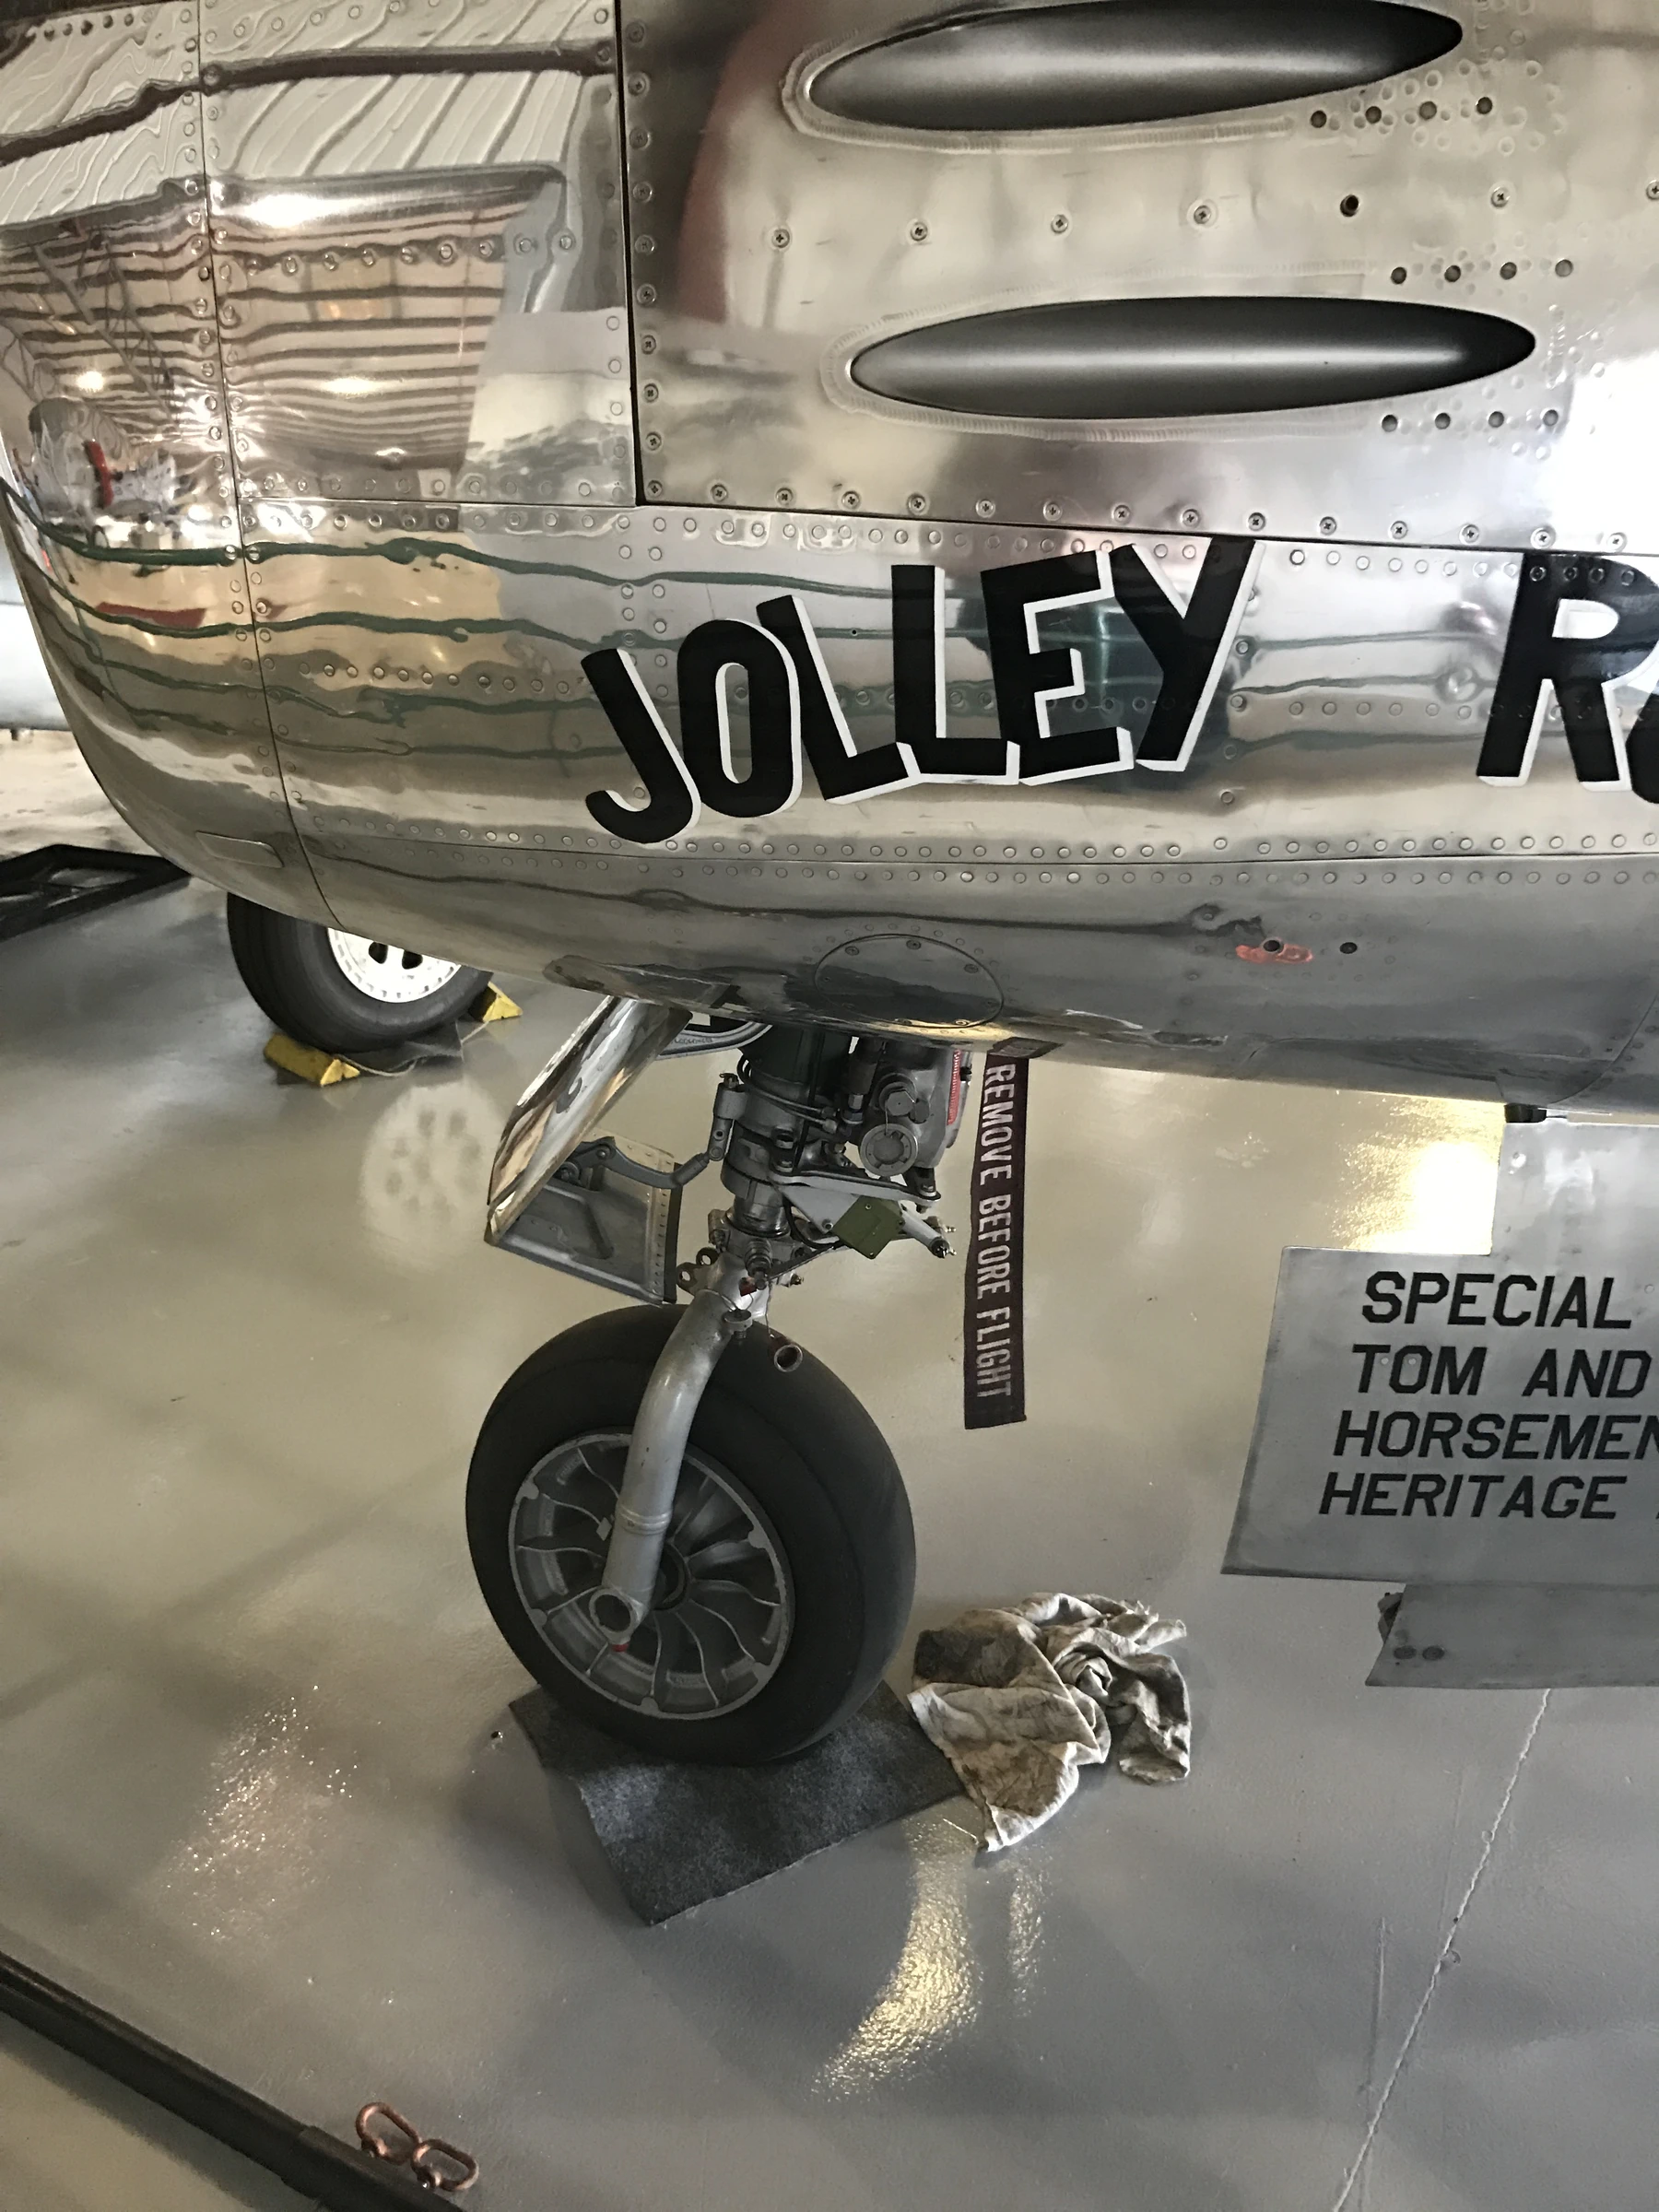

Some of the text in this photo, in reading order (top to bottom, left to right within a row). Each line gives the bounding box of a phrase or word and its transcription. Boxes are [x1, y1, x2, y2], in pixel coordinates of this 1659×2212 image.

[581, 537, 1659, 845] JOLLEY R
[976, 1063, 1017, 1398] REMOVE BEFORE FLIGHT
[1361, 1270, 1632, 1329] SPECIAL
[1352, 1344, 1653, 1398] TOM AND
[1318, 1471, 1628, 1520] HERITAGE
